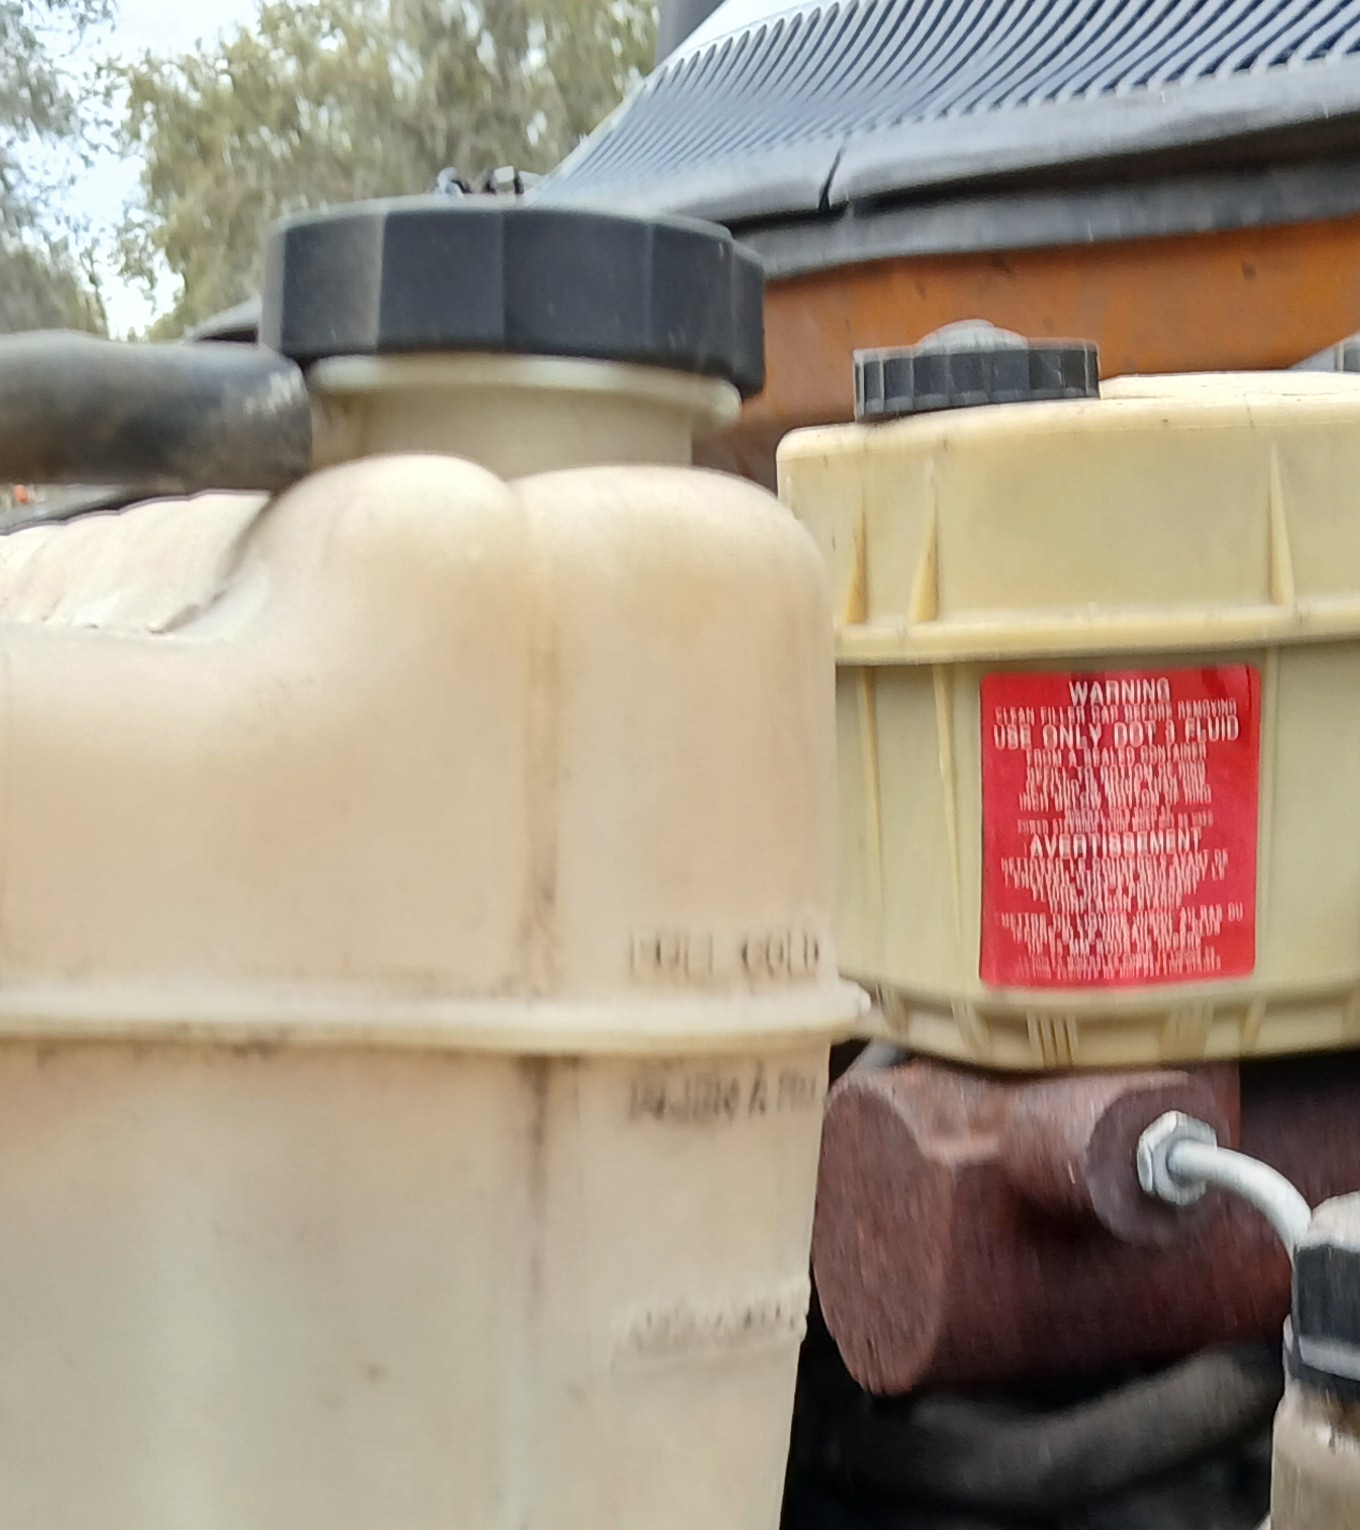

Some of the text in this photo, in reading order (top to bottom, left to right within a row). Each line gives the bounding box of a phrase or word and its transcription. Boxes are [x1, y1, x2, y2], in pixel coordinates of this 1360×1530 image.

[1069, 677, 1171, 706] WARNING
[993, 723, 1031, 749] USE
[1042, 720, 1102, 748] ONLY
[1113, 720, 1156, 748] DOT
[1185, 715, 1240, 744] FLUID
[1030, 828, 1202, 858] AVERTISSEMENT
